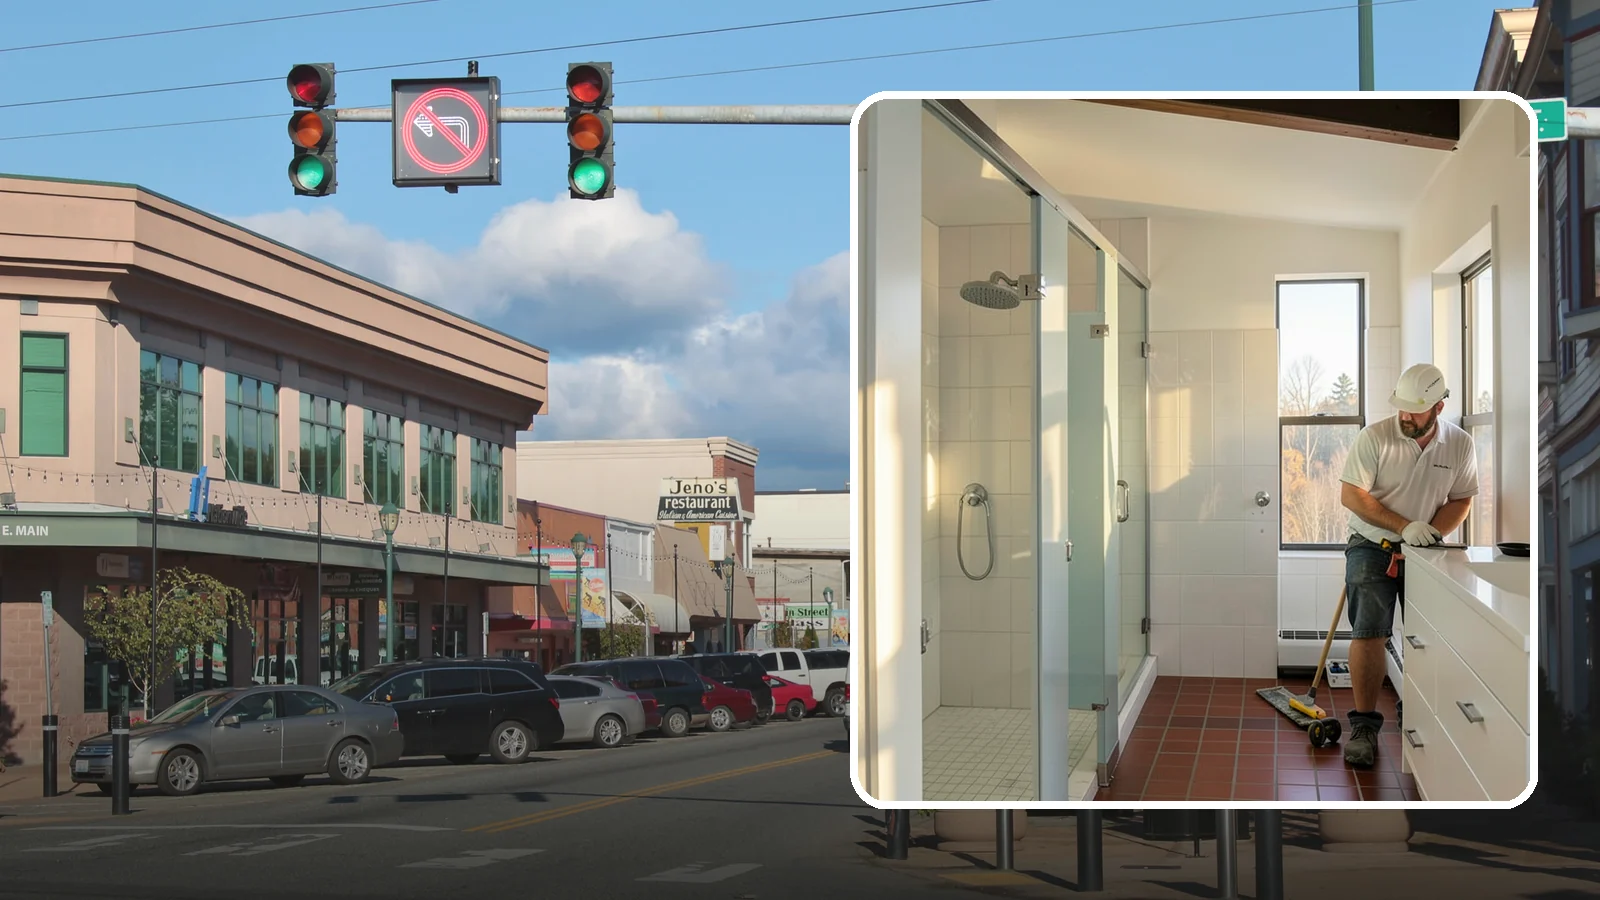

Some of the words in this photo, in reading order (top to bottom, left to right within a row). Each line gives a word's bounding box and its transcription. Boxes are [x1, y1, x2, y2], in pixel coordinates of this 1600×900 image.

[669, 480, 728, 494] Jeno's
[665, 496, 731, 509] restaurant
[686, 509, 714, 519] American
[715, 509, 738, 519] Cuisine
[2, 525, 13, 536] E.
[15, 525, 49, 536] MAIN
[797, 607, 828, 617] Street
